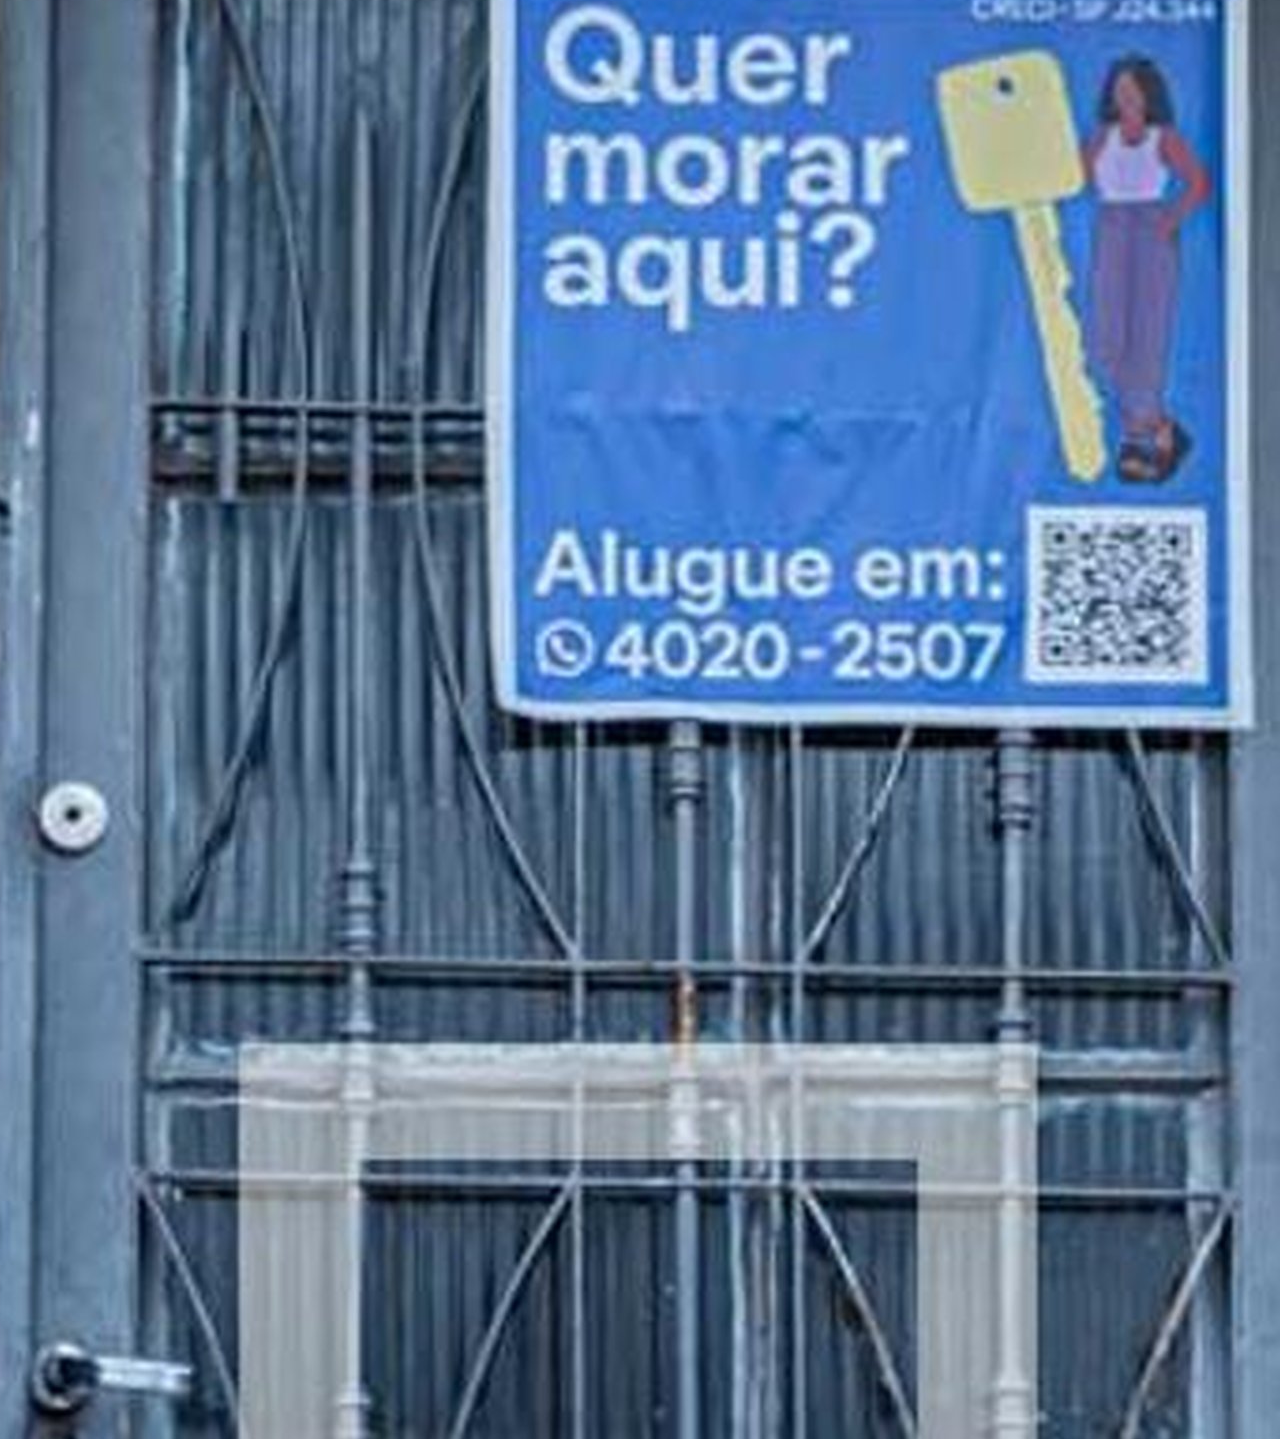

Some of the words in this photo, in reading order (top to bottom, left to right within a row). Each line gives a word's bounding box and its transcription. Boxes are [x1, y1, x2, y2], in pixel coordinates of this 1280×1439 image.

[543, 4, 851, 106] Quer
[543, 131, 909, 205] morar
[542, 211, 876, 332] aqui?
[533, 530, 832, 615] Alugue
[853, 546, 1008, 599] em:
